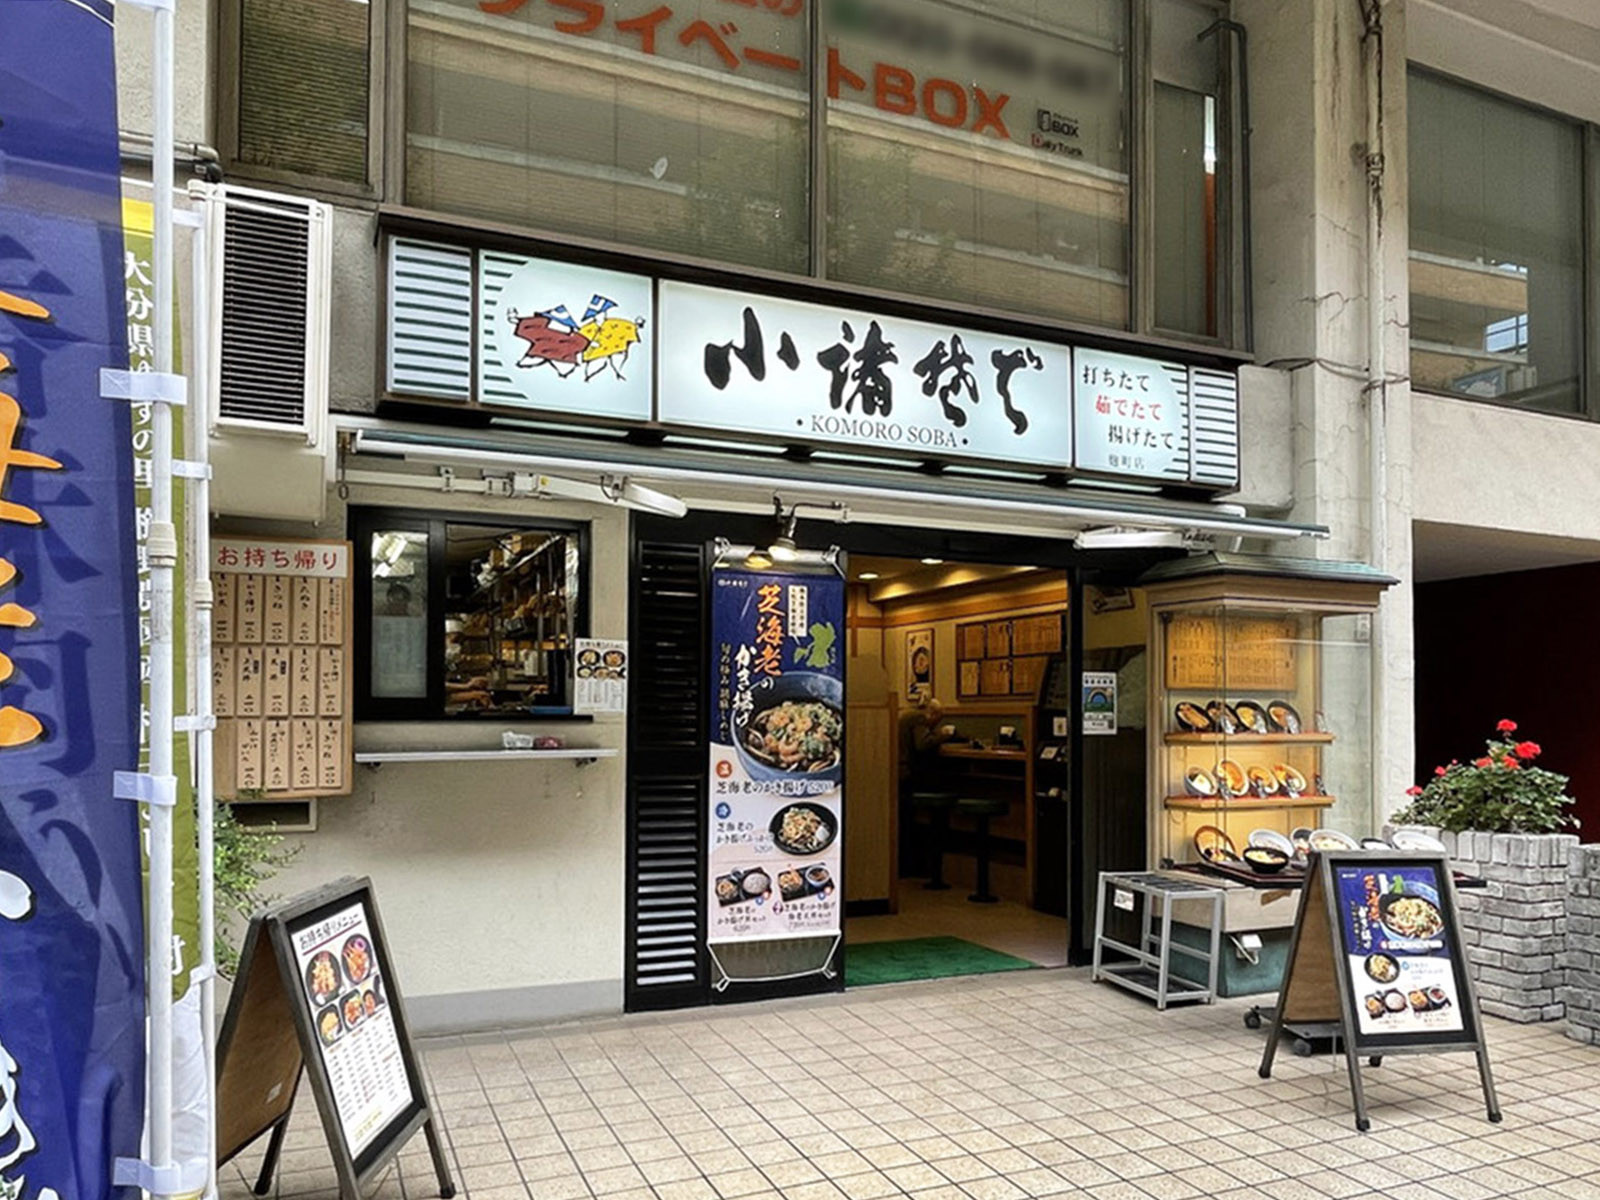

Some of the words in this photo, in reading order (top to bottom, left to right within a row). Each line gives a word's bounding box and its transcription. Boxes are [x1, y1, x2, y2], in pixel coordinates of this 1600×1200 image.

[1083, 365, 1150, 392] 打ちたて
[1095, 394, 1162, 421] 茹でたて
[811, 414, 903, 443] KOMORO
[906, 422, 959, 449] SOBA
[1108, 424, 1174, 450] 揚げたて
[217, 546, 338, 570] お持ち帰り
[732, 643, 757, 729] かき揚げ
